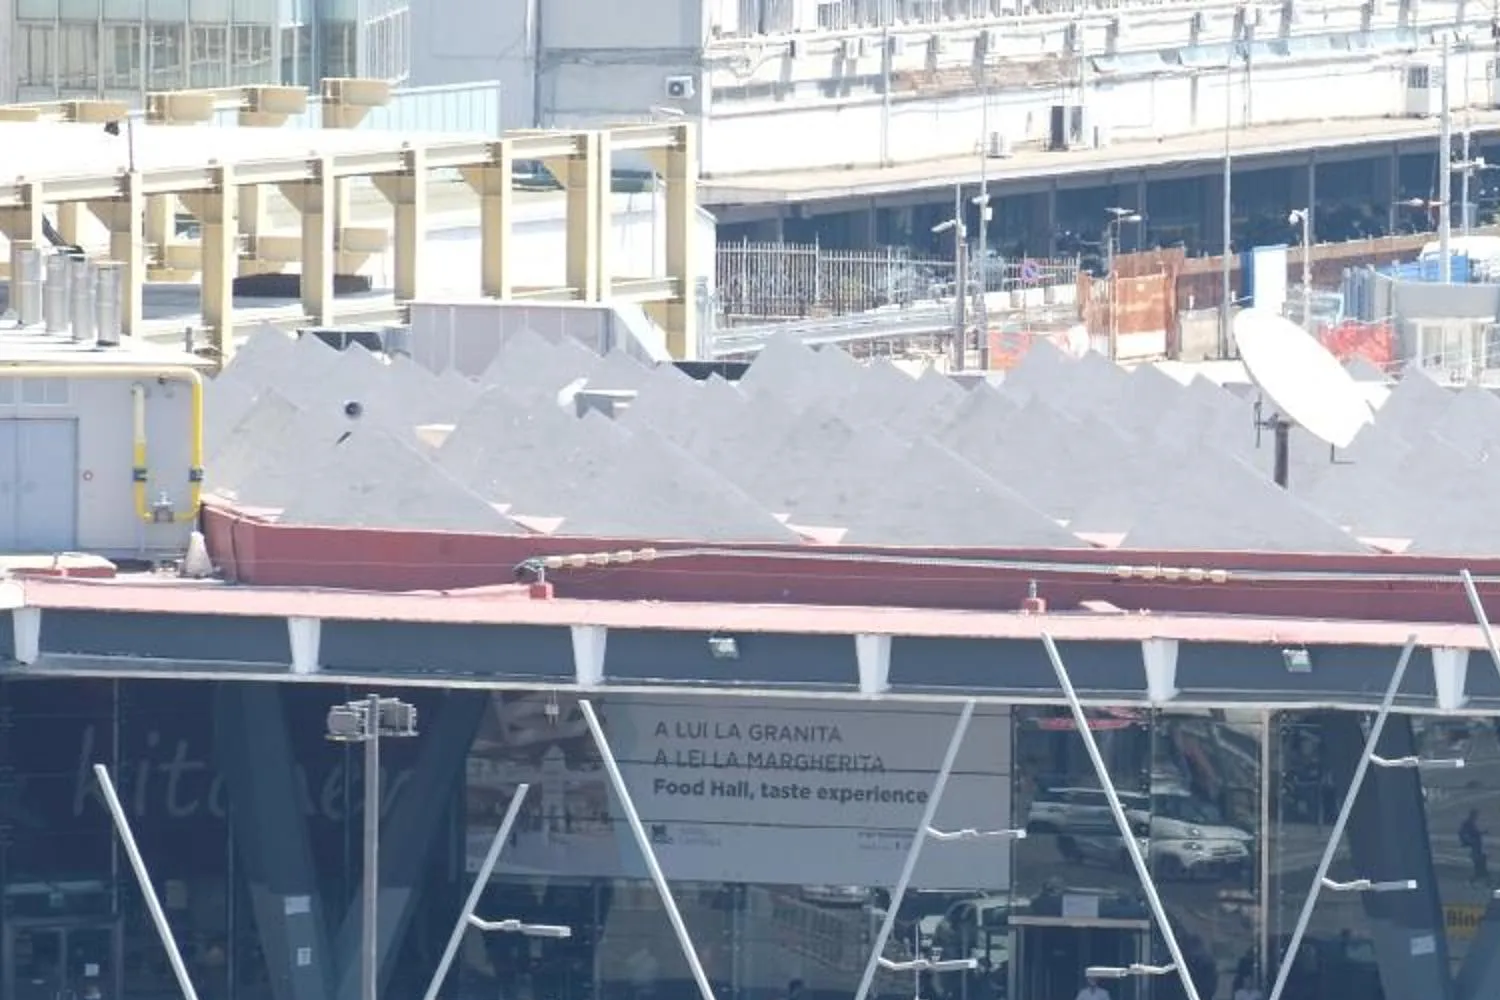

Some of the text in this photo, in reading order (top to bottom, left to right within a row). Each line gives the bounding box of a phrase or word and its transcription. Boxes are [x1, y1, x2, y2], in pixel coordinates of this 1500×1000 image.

[654, 720, 843, 743] A LUI LA GRANITA
[654, 748, 669, 767] A
[747, 751, 886, 773] MARGHERITA
[653, 778, 930, 805] Food Hall, taste experience
